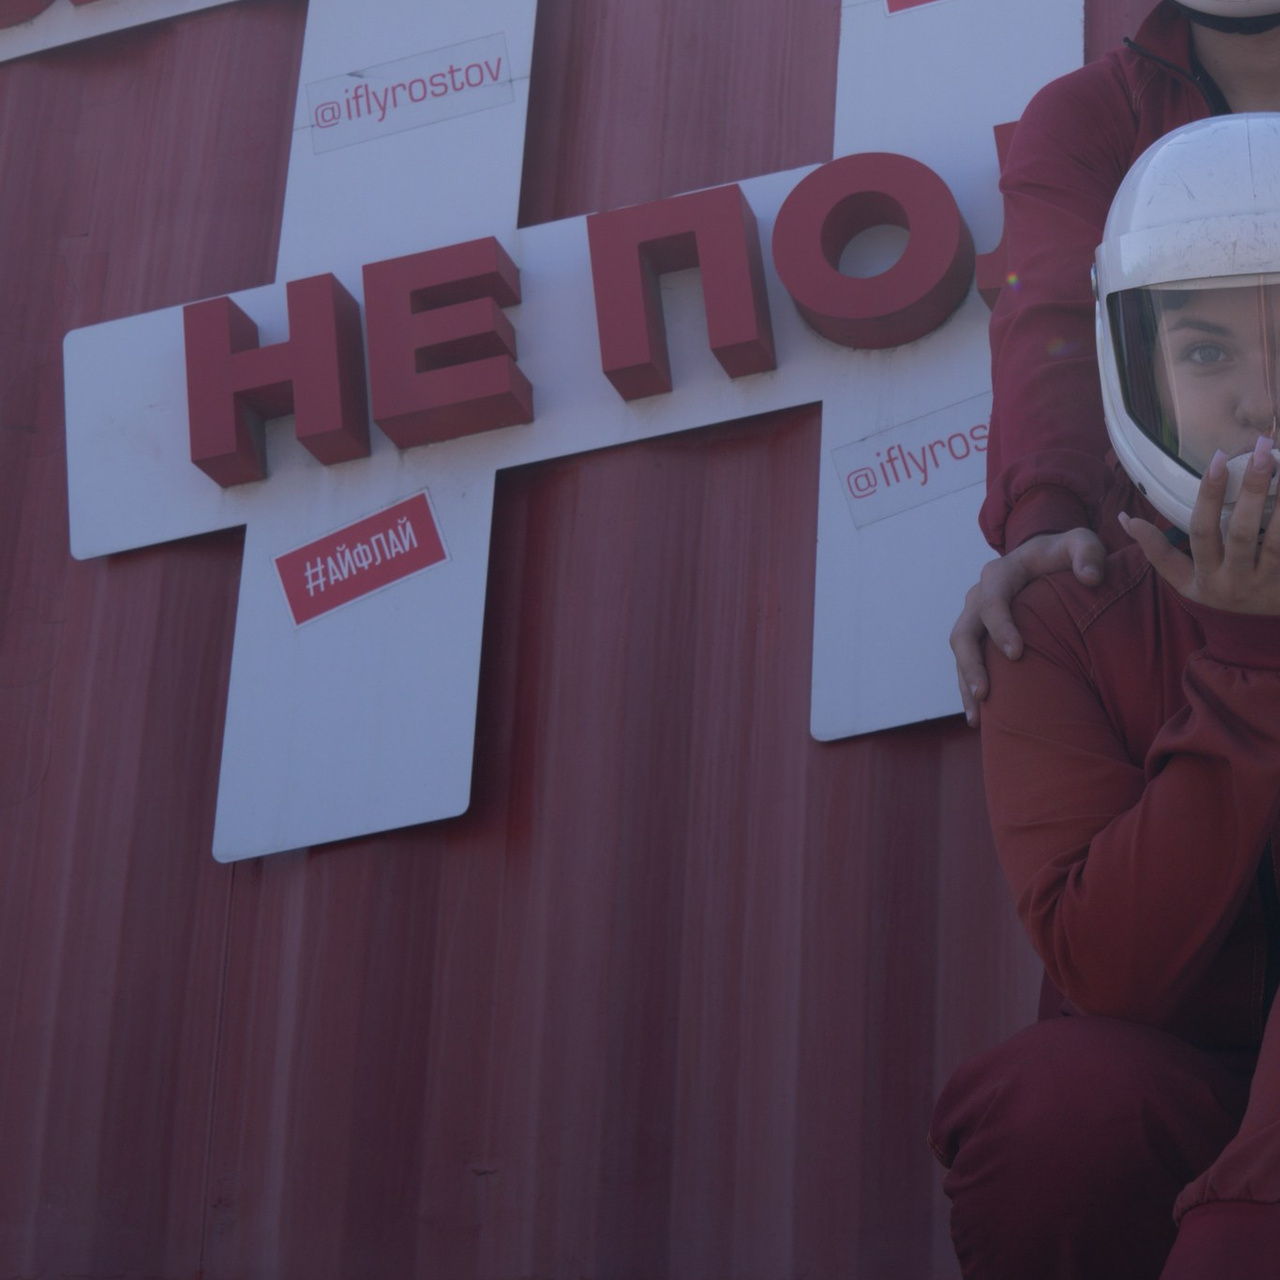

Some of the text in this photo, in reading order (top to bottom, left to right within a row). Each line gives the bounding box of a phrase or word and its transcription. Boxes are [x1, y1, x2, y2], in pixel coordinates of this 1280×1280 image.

[314, 57, 502, 129] @iflyrostov
[183, 236, 534, 488] НЕ
[304, 516, 418, 596] #АЙФЛАЙ
